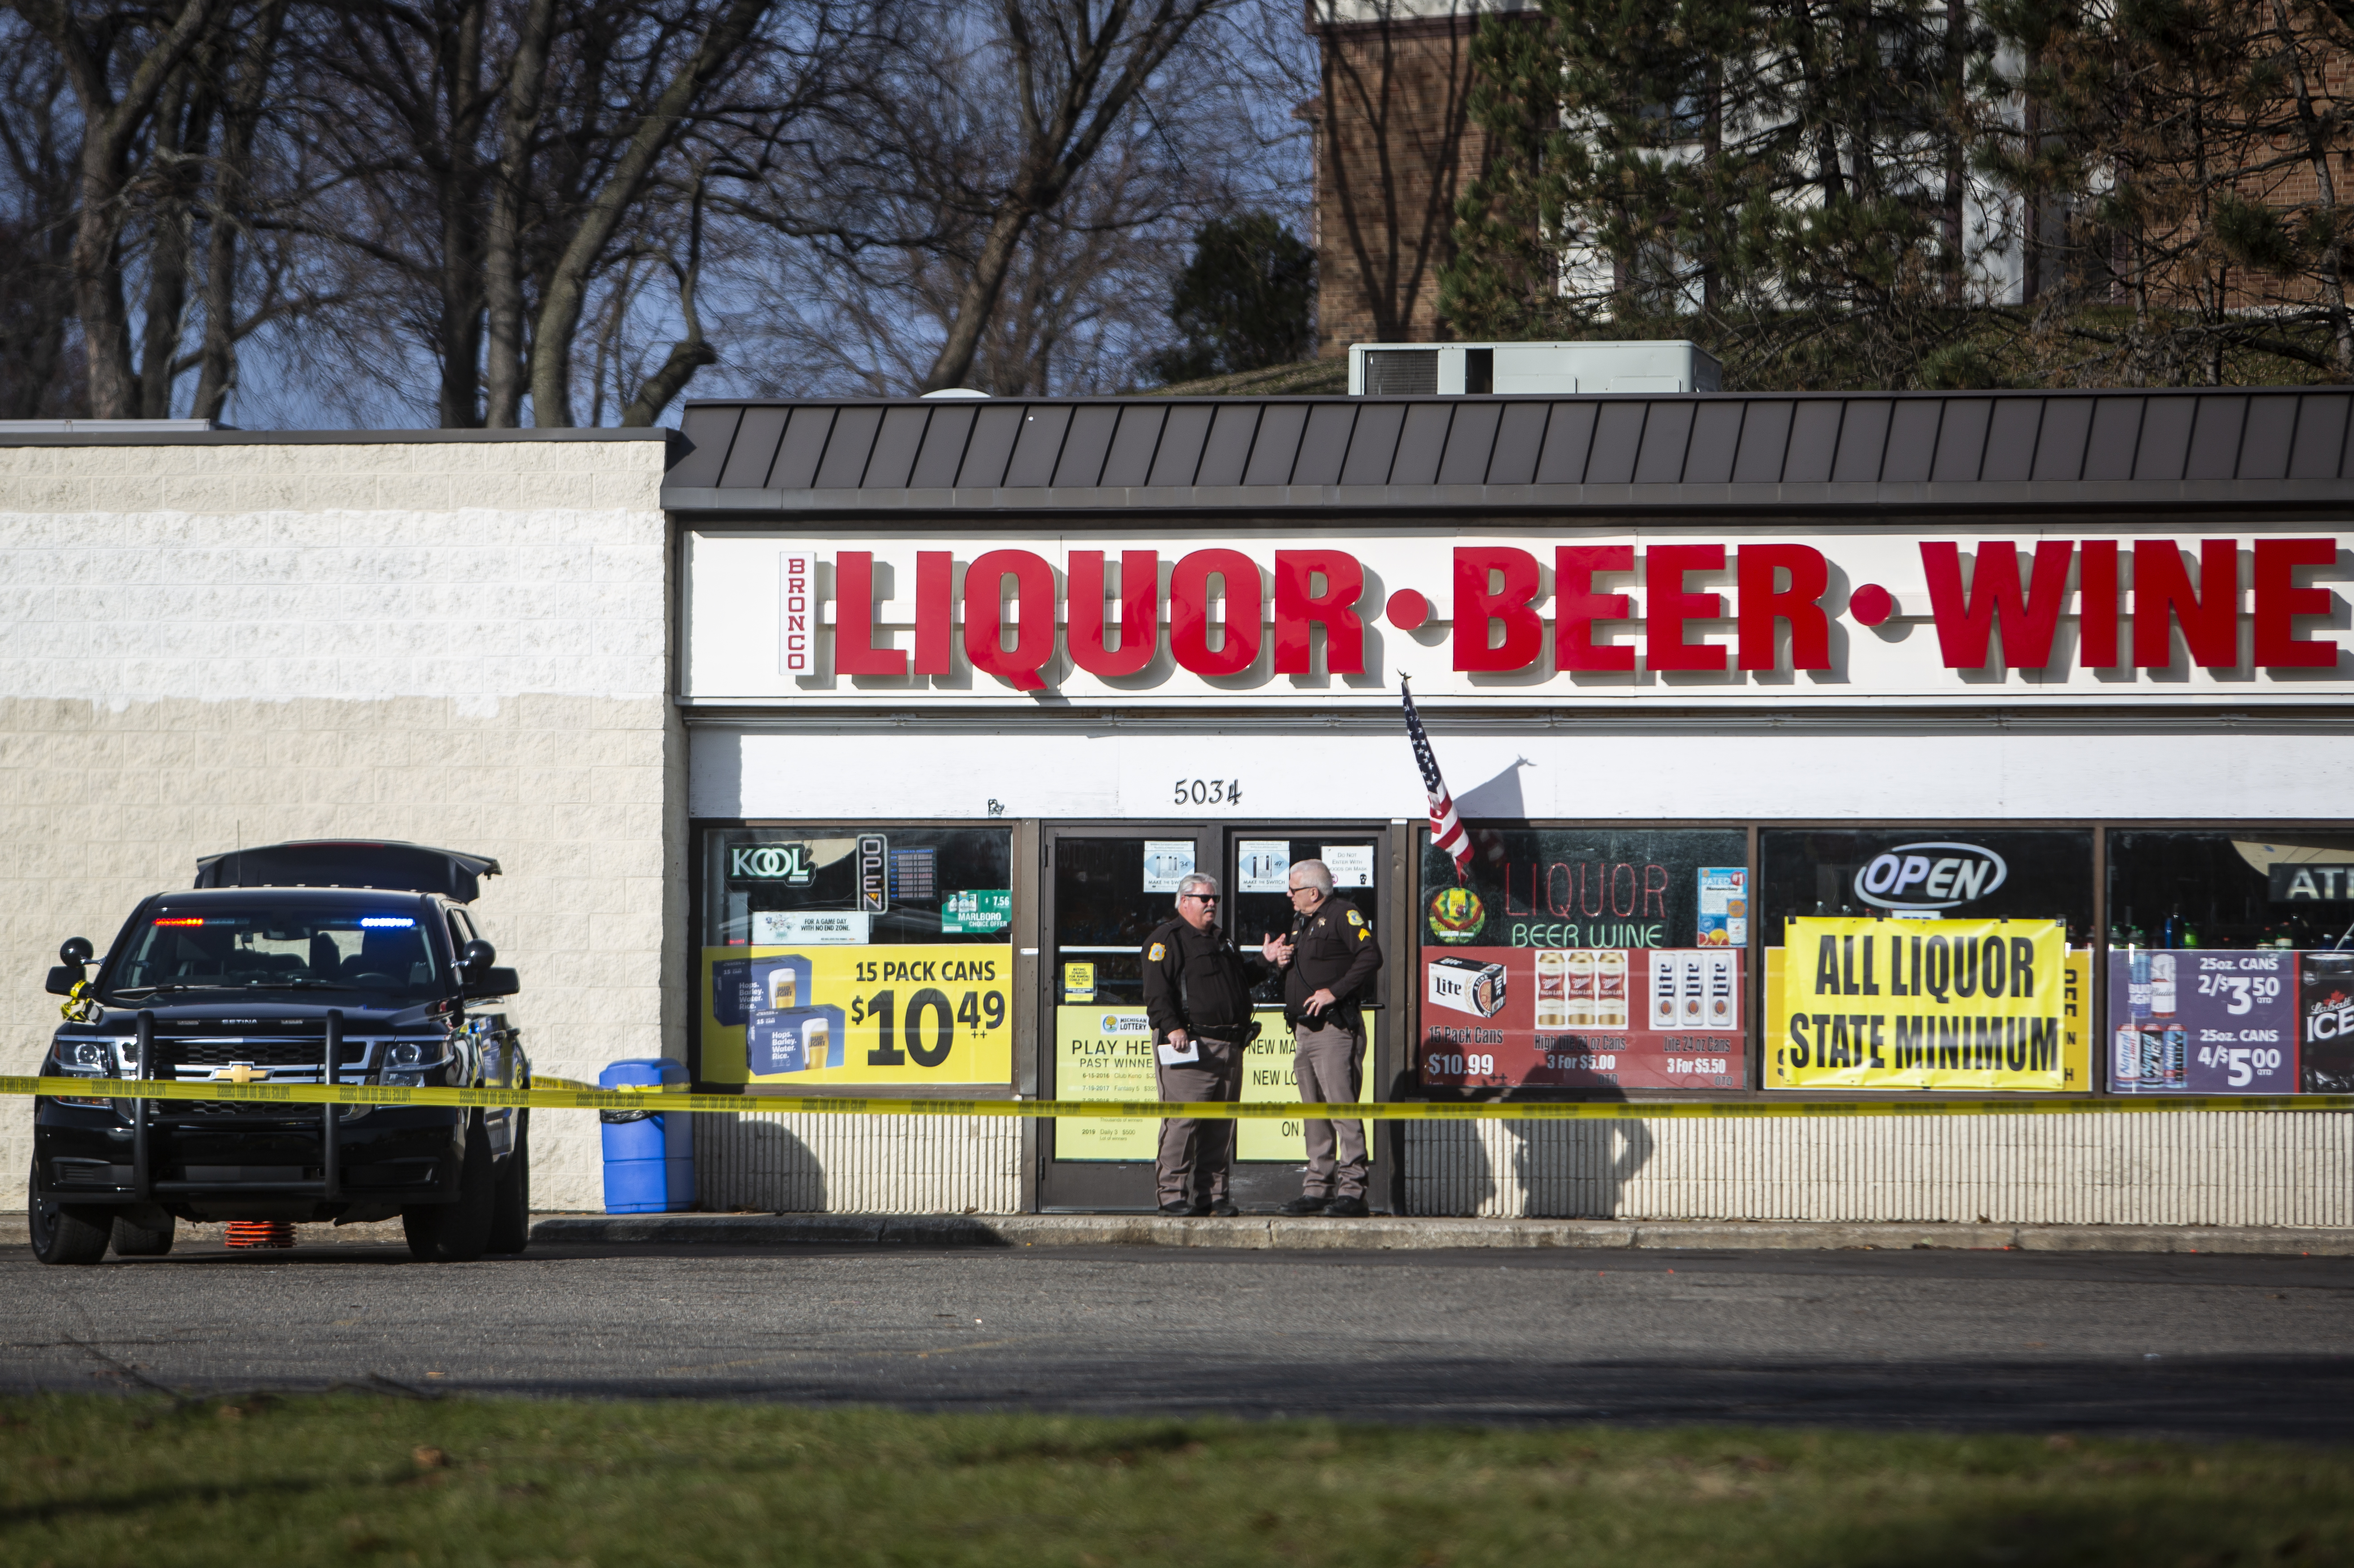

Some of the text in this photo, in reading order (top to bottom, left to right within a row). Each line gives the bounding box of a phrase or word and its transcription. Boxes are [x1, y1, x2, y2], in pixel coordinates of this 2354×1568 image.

[788, 559, 805, 669] BRONCO
[835, 538, 2337, 691] LIQUOR BEER WINE
[1174, 779, 1242, 806] 5034
[732, 847, 810, 876] KOOL
[862, 840, 882, 911] OPEN
[1732, 872, 1743, 885] #1
[1865, 854, 1990, 900] OPEN
[1506, 863, 1668, 920] LIQUOR
[993, 896, 1009, 906] 7.56
[958, 912, 1001, 921] MARLBORO
[1512, 923, 1663, 948] BEER WINE
[856, 960, 996, 982] 15 PACK CANS
[1815, 935, 2034, 1004] ALL LIQUOR
[2200, 957, 2279, 970] 25oz. CANS
[1436, 976, 1462, 996] Lite
[2310, 996, 2354, 1015] Labatt
[2306, 1005, 2354, 1042] ICE
[1429, 1026, 1503, 1044] 15 Pack Cans
[1534, 1034, 1556, 1052] High
[1577, 1034, 1588, 1050] 24
[1590, 1037, 1601, 1050] oz
[1602, 1034, 1626, 1051] Cans
[1682, 1035, 1694, 1052] 24
[1695, 1038, 1706, 1052] oz
[1707, 1035, 1731, 1053] Cans
[1790, 1013, 1885, 1068] STATE
[1895, 1015, 2058, 1071] MINIMUM
[2200, 1029, 2279, 1042] 25oz. CANS
[1072, 1040, 1151, 1055] PLAY HE
[1248, 1039, 1296, 1054] NEW MA
[1080, 1058, 1153, 1067] PAST WINNE
[1428, 1053, 1494, 1075] $10.99
[1547, 1053, 1616, 1070] 3 For $5.00
[1667, 1057, 1726, 1074] 3 For $5.50
[1254, 1070, 1280, 1085] NEW
[1282, 1121, 1299, 1136] ON
